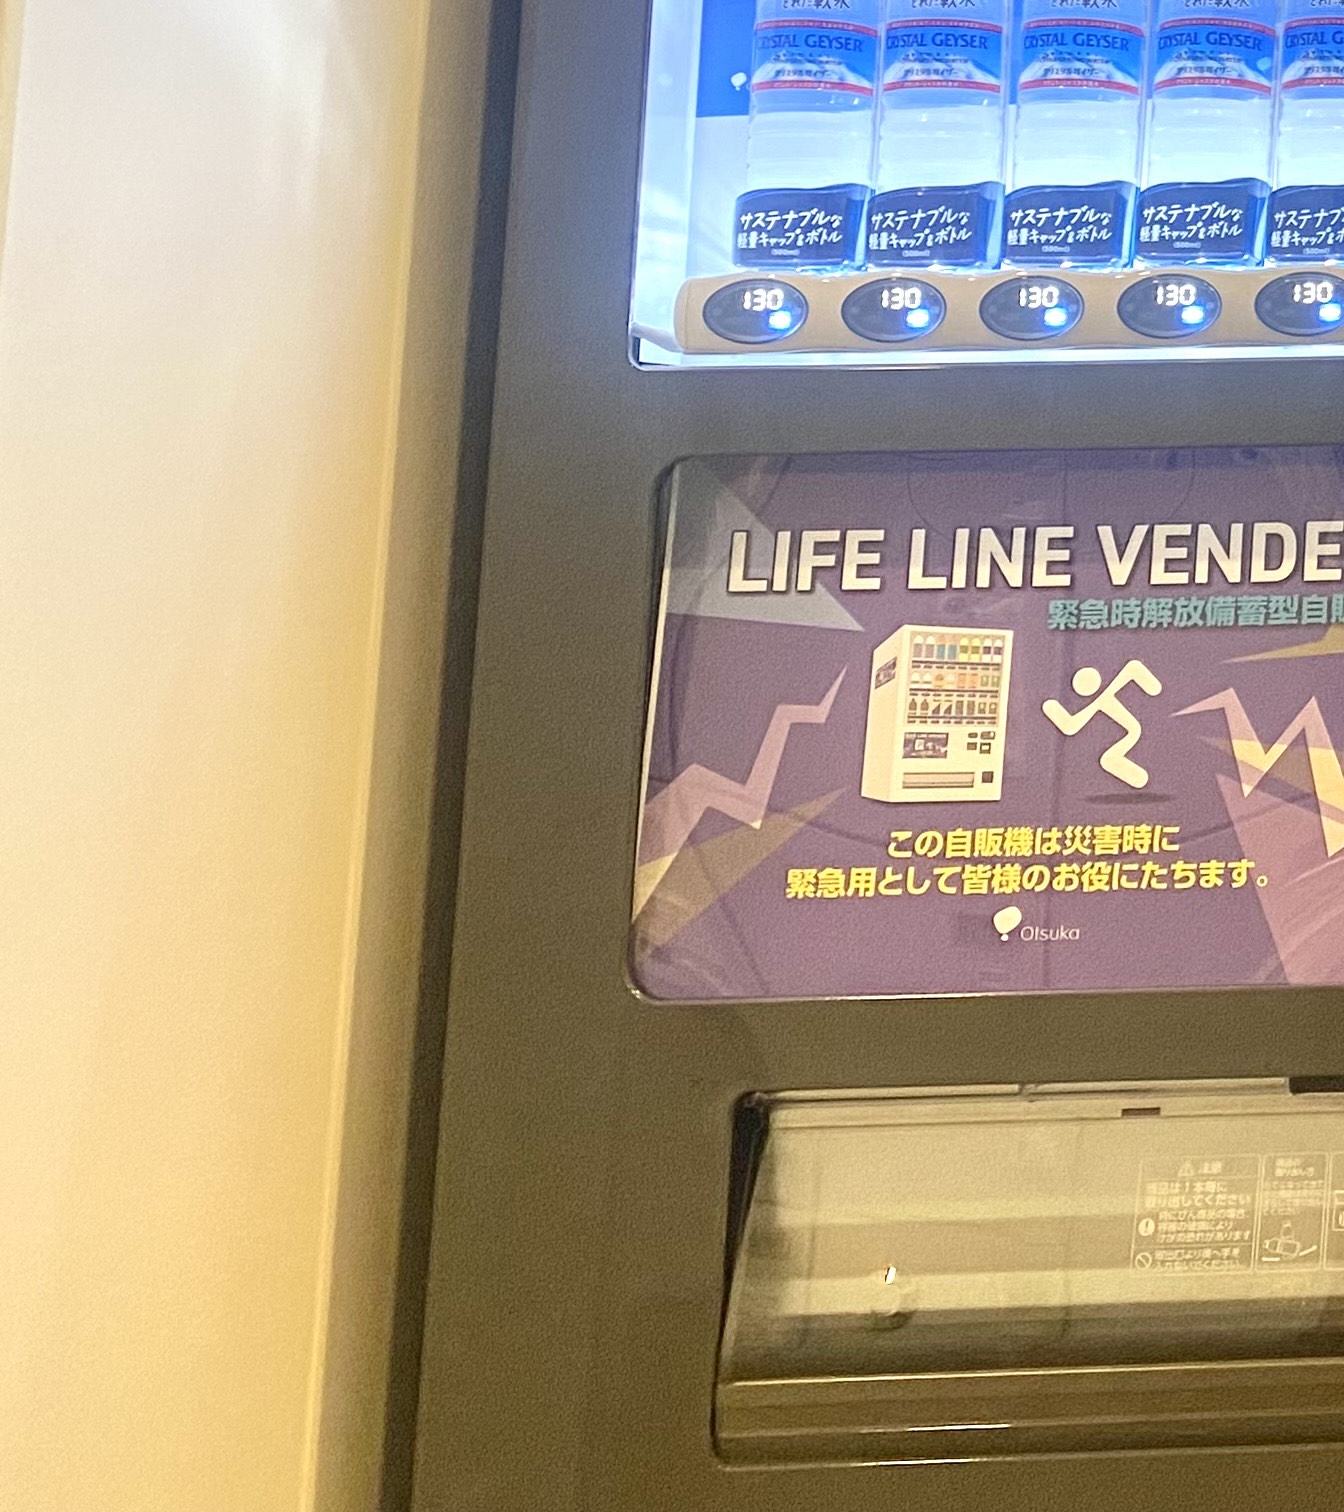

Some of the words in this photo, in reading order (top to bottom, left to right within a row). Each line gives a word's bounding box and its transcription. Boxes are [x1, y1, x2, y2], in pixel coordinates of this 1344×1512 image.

[740, 208, 842, 229] サステナブルな
[743, 289, 784, 311] 130
[1018, 286, 1059, 308] 130
[1293, 282, 1333, 304] 130
[727, 528, 886, 592] LIFE
[907, 525, 1074, 590] LINE
[887, 823, 1180, 859] この自販機は災害時に
[785, 858, 1271, 899] 緊急用として皆様のお役にたちます。
[1020, 925, 1081, 942] Otsuka
